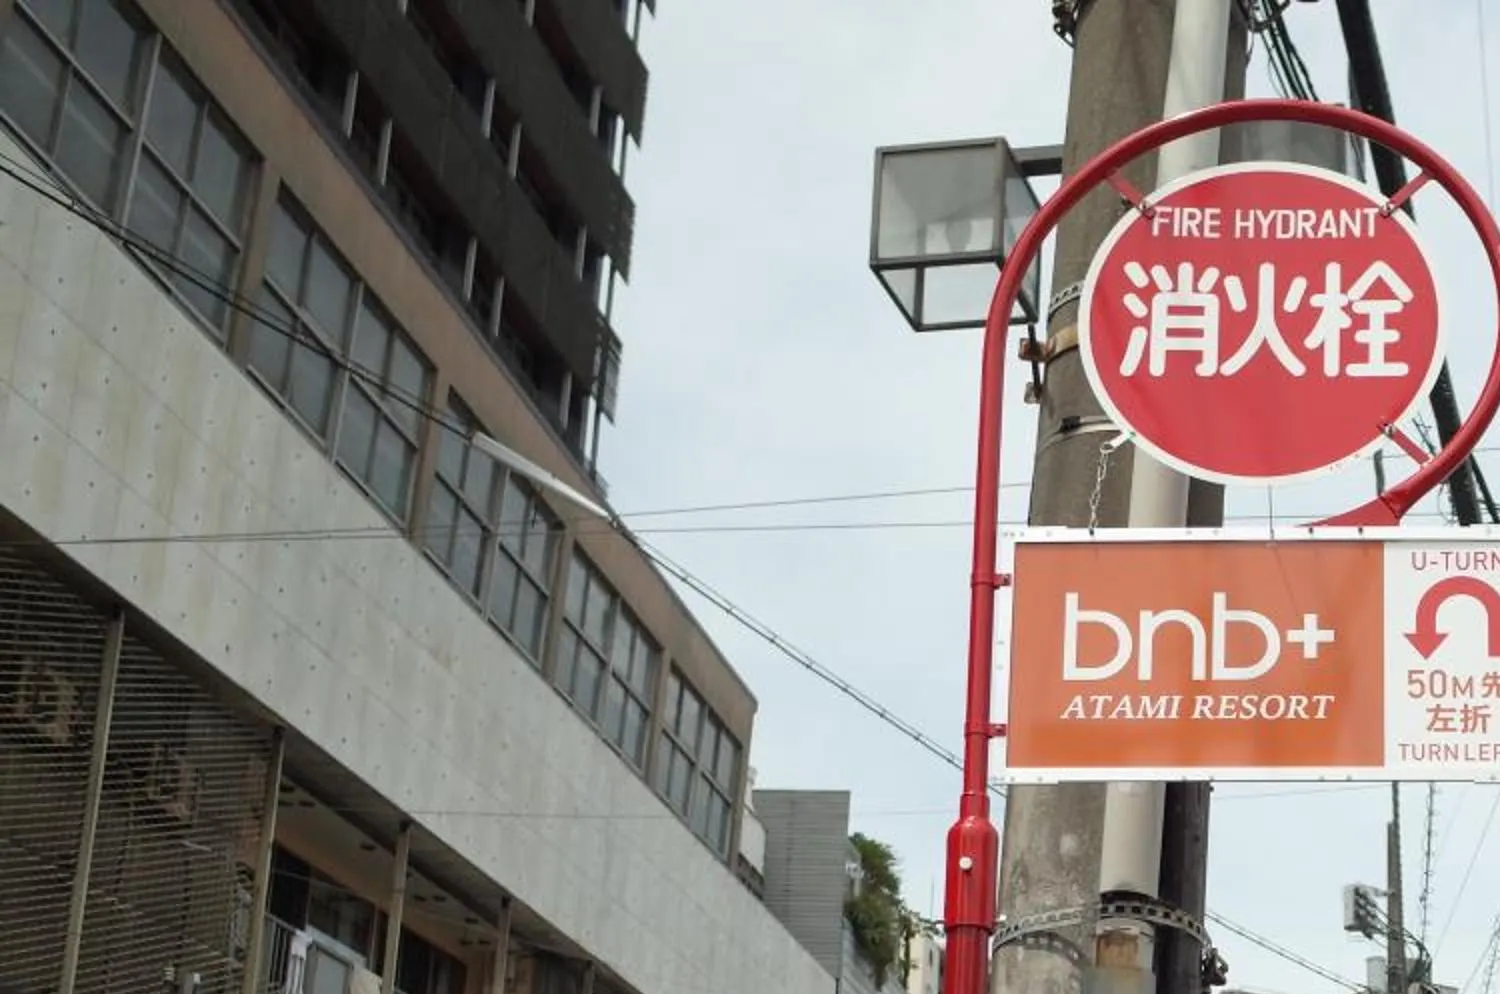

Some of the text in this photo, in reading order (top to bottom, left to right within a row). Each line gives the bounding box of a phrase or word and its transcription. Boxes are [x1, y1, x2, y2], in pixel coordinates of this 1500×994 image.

[1151, 206, 1379, 240] FIRE HYDRANT
[1119, 260, 1415, 378] 消火栓
[1059, 694, 1336, 720] ATAMI RESORT
[1425, 703, 1493, 735] 左折
[1397, 742, 1459, 762] TURN
